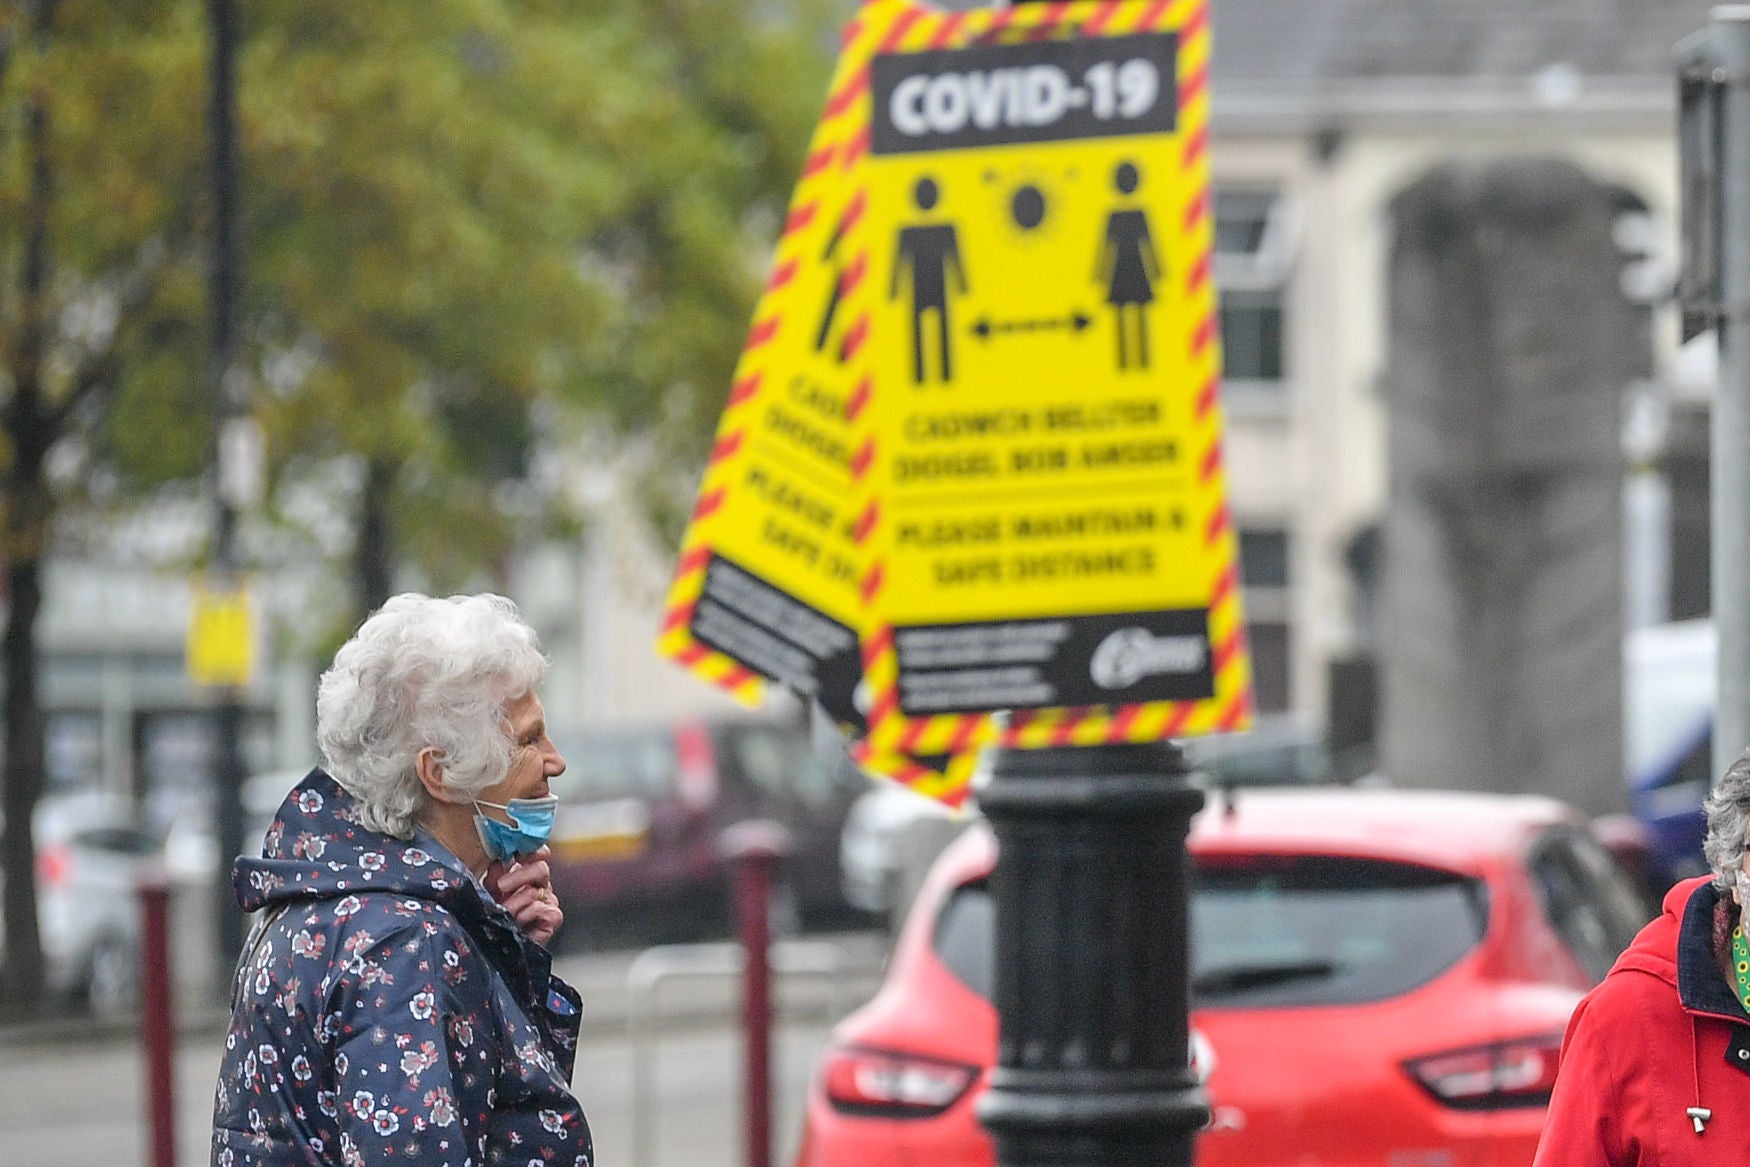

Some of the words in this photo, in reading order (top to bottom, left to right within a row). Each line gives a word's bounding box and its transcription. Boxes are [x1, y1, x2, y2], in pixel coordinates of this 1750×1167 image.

[889, 57, 1160, 136] COVID-19
[898, 517, 1002, 548] PLEASE
[1013, 508, 1156, 541] MAINTAIN
[931, 558, 1002, 589] SAFE
[1013, 548, 1156, 580] DISTANCE
